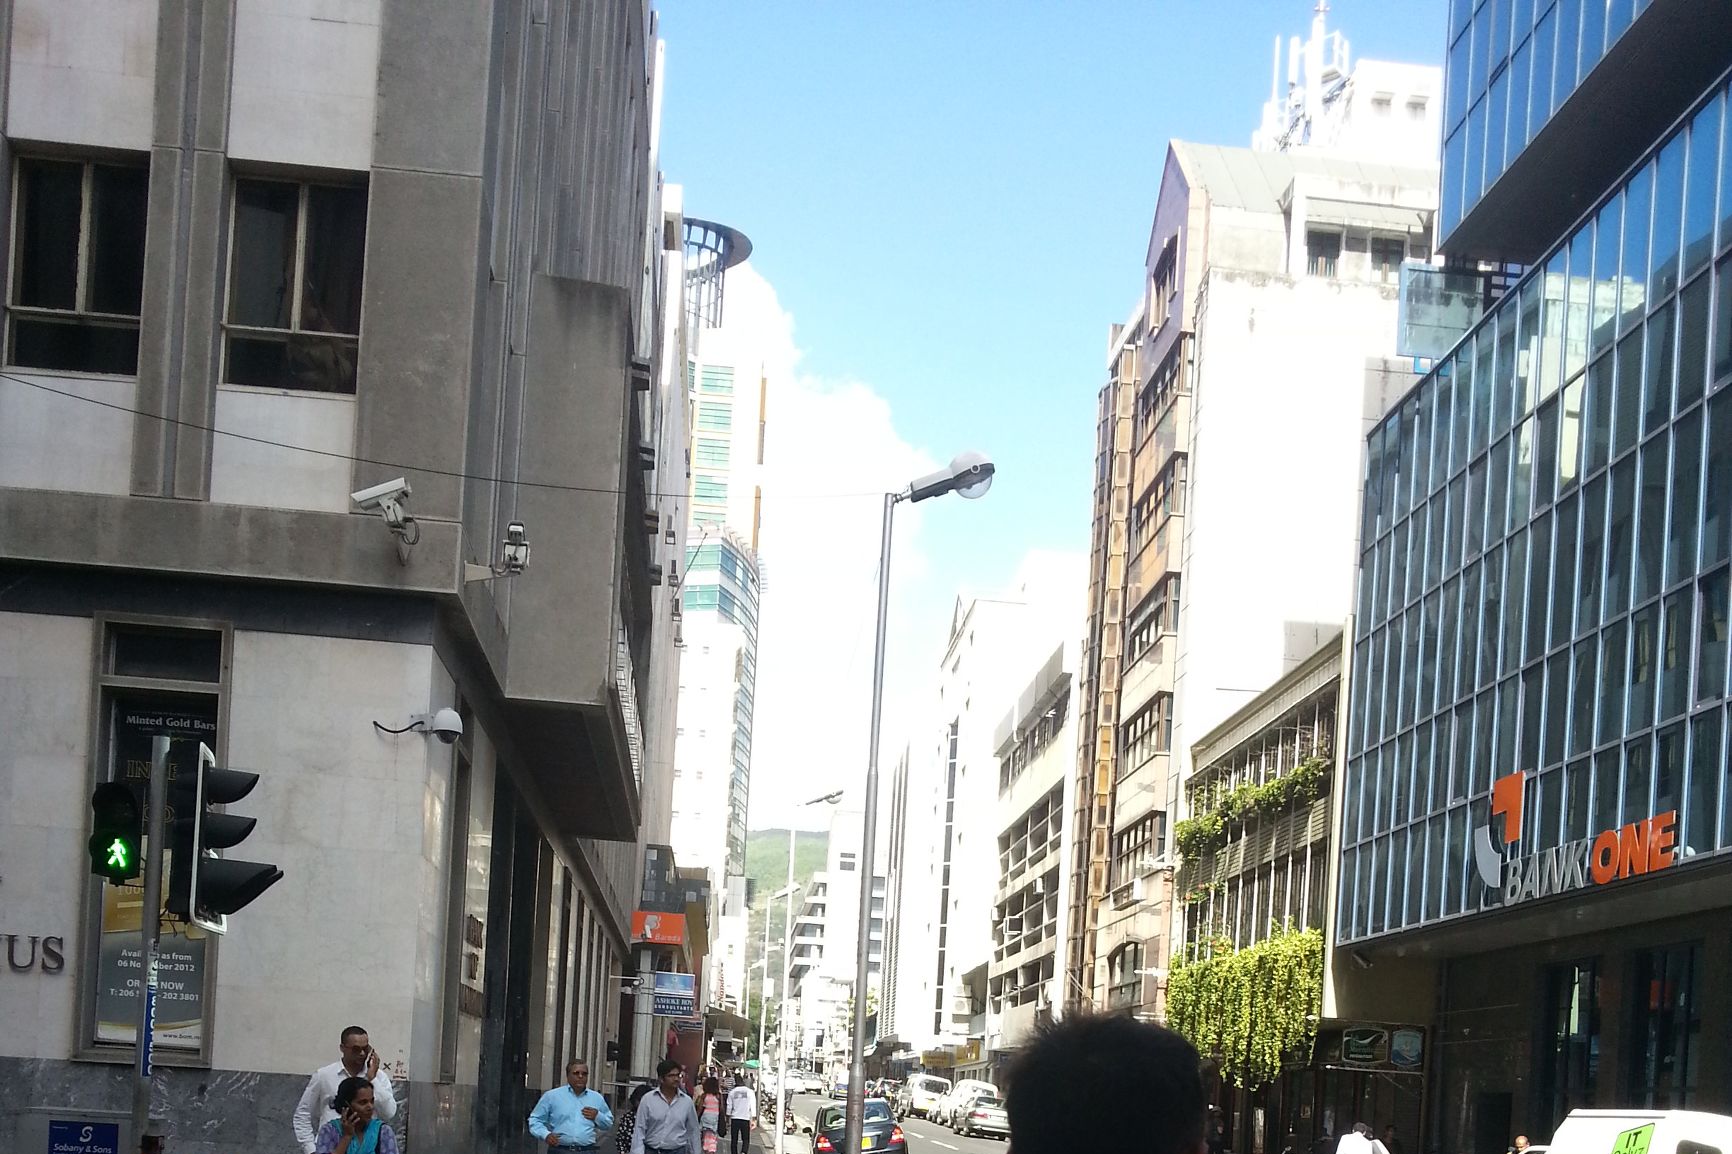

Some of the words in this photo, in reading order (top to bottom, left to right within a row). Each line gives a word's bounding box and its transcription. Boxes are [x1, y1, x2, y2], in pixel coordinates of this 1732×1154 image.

[126, 715, 163, 726] Minted
[165, 717, 191, 728] Gold
[194, 720, 216, 731] Bars
[1504, 838, 1588, 907] BANK
[1590, 809, 1677, 885] ONE
[0, 933, 65, 972] US
[161, 952, 171, 960] as
[172, 952, 192, 961] from
[117, 959, 128, 967] 06
[129, 960, 172, 971] Nober
[174, 963, 195, 972] 2012
[160, 981, 185, 991] NOW
[119, 989, 134, 997] 206
[162, 992, 178, 1000] 202
[1625, 1130, 1643, 1149] IT
[53, 1143, 84, 1154] Sobany
[92, 1145, 112, 1154] Sons
